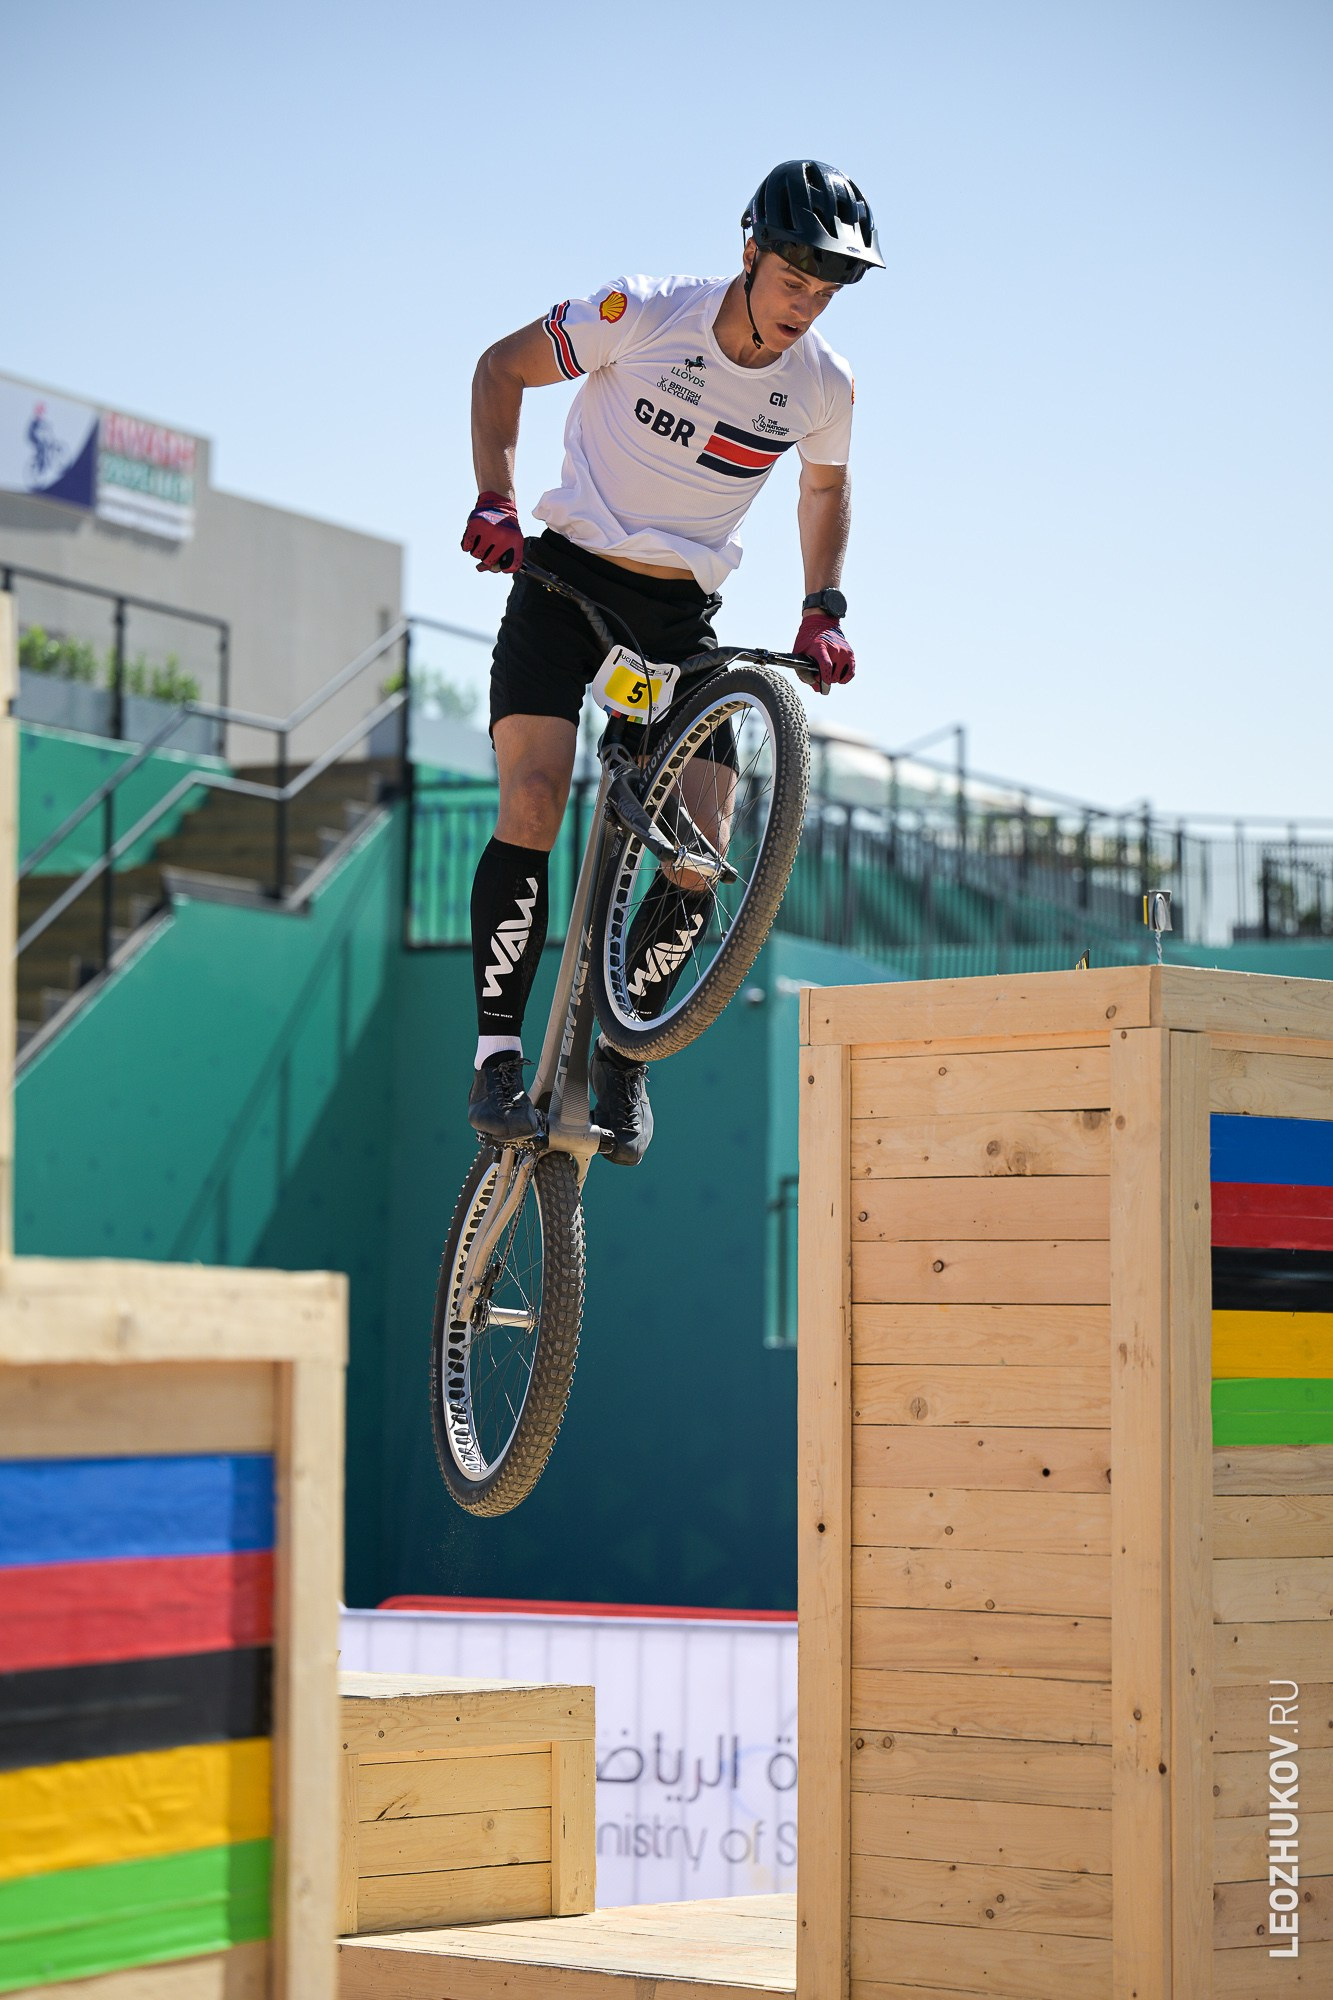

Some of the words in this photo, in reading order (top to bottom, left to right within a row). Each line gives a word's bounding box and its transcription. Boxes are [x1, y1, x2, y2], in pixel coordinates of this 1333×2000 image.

[670, 366, 706, 388] LLOYDS
[666, 387, 699, 406] CYCLING
[669, 381, 702, 401] BRITISH
[634, 397, 696, 448] GBR
[764, 427, 788, 437] LOTTERY
[766, 423, 790, 433] NATIONAL
[767, 418, 778, 426] THE
[621, 653, 632, 664] UCI
[626, 680, 648, 704] 5
[638, 731, 674, 794] ATIONAL
[596, 1731, 739, 1803] الرياض
[597, 1814, 708, 1872] nistry
[719, 1819, 767, 1864] of
